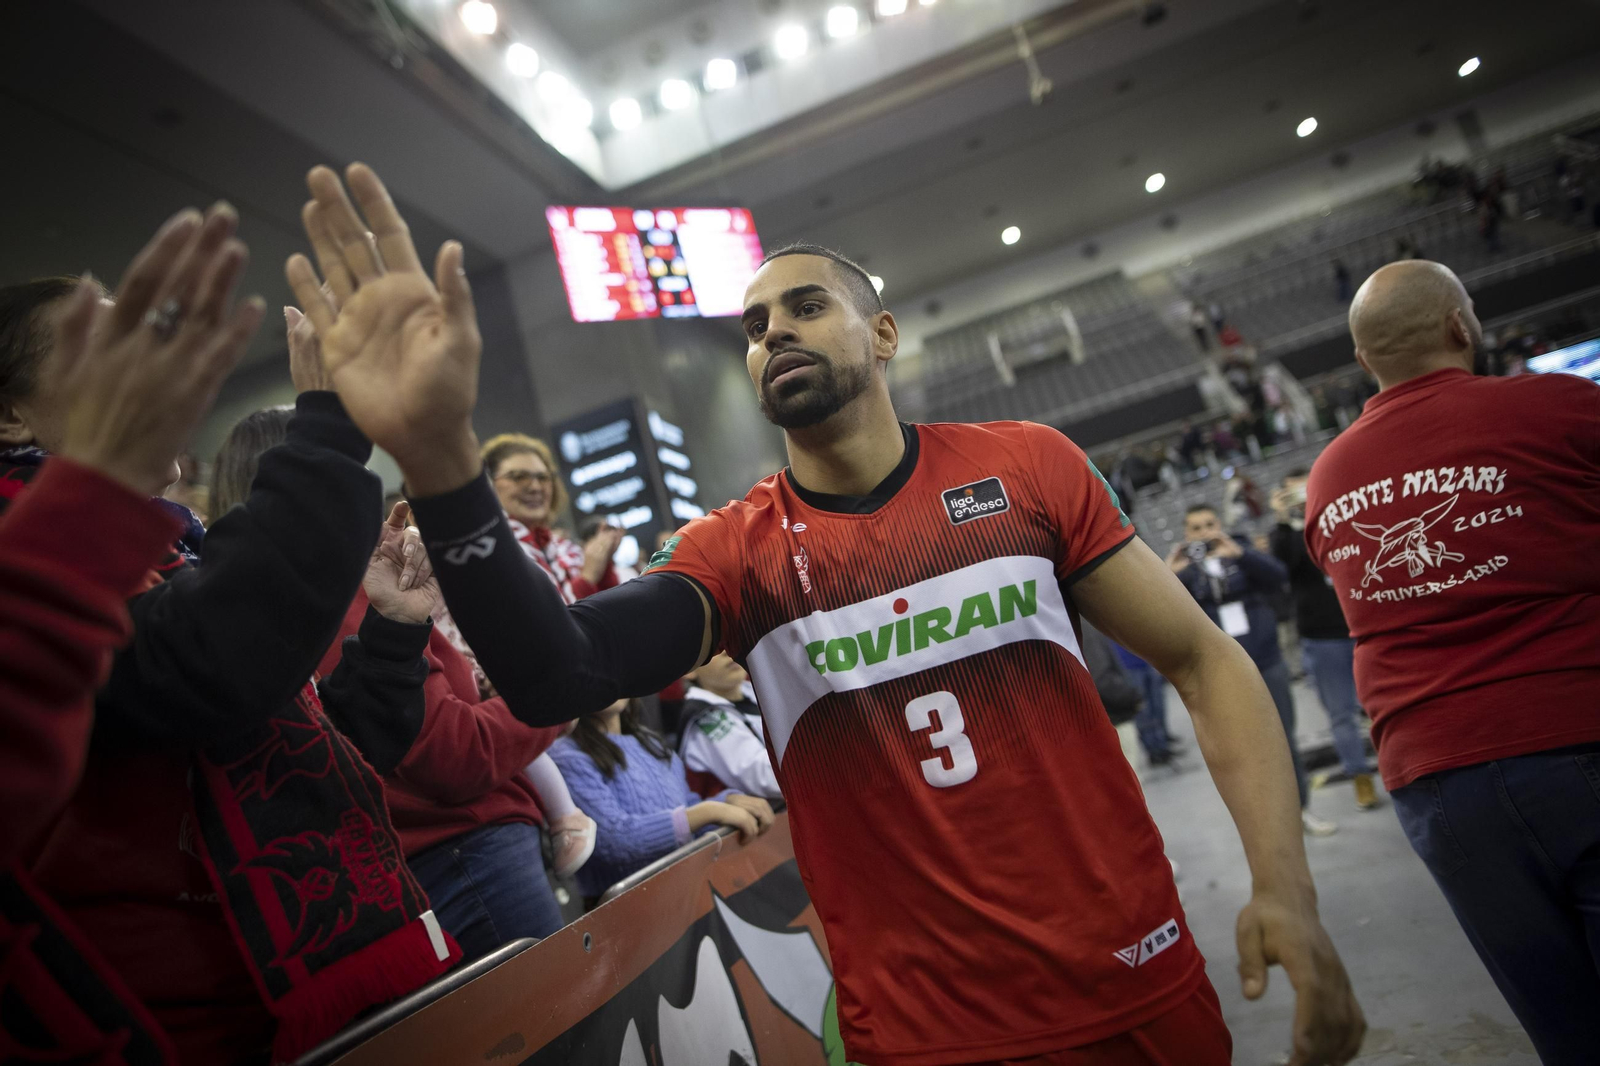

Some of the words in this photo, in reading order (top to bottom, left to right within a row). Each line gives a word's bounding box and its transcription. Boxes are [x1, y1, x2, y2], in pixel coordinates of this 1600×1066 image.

[950, 496, 974, 509] liga
[954, 498, 1005, 518] endesa
[1318, 477, 1394, 538] FRENTE
[1452, 504, 1524, 532] 2024
[1328, 543, 1361, 564] 1994
[1350, 588, 1363, 601] 30
[1366, 555, 1509, 603] ANIVERSARIO
[904, 690, 978, 789] 3
